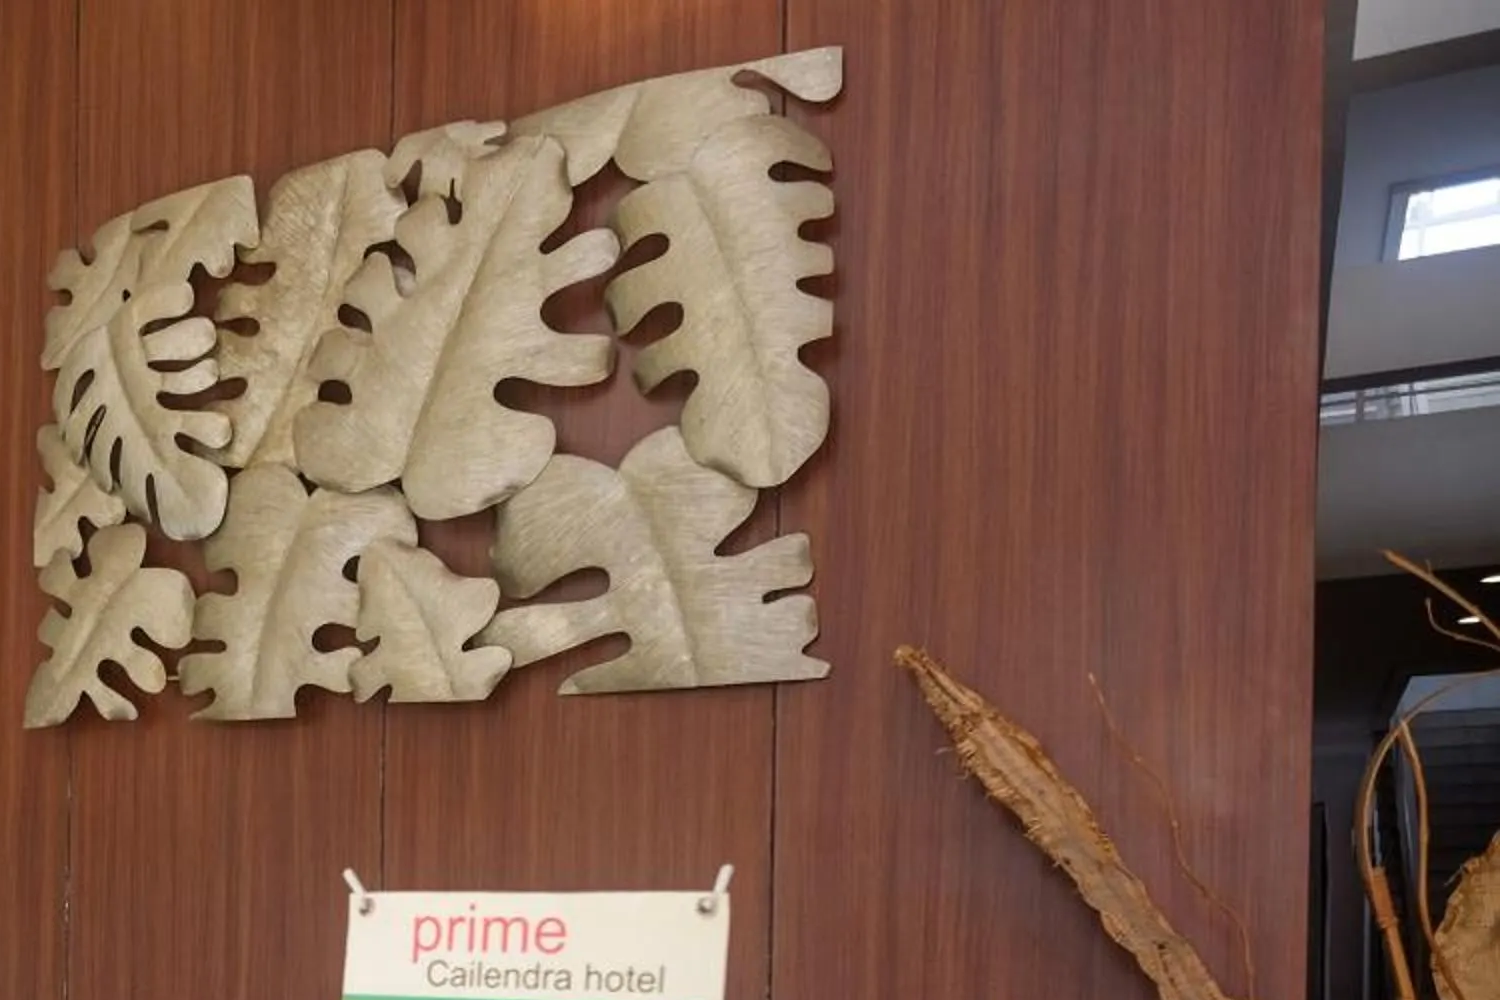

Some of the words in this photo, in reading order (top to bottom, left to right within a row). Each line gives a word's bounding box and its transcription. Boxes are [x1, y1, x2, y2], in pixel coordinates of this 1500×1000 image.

[412, 903, 567, 964] prime
[426, 959, 572, 991] Cailendra
[584, 963, 665, 993] hotel
